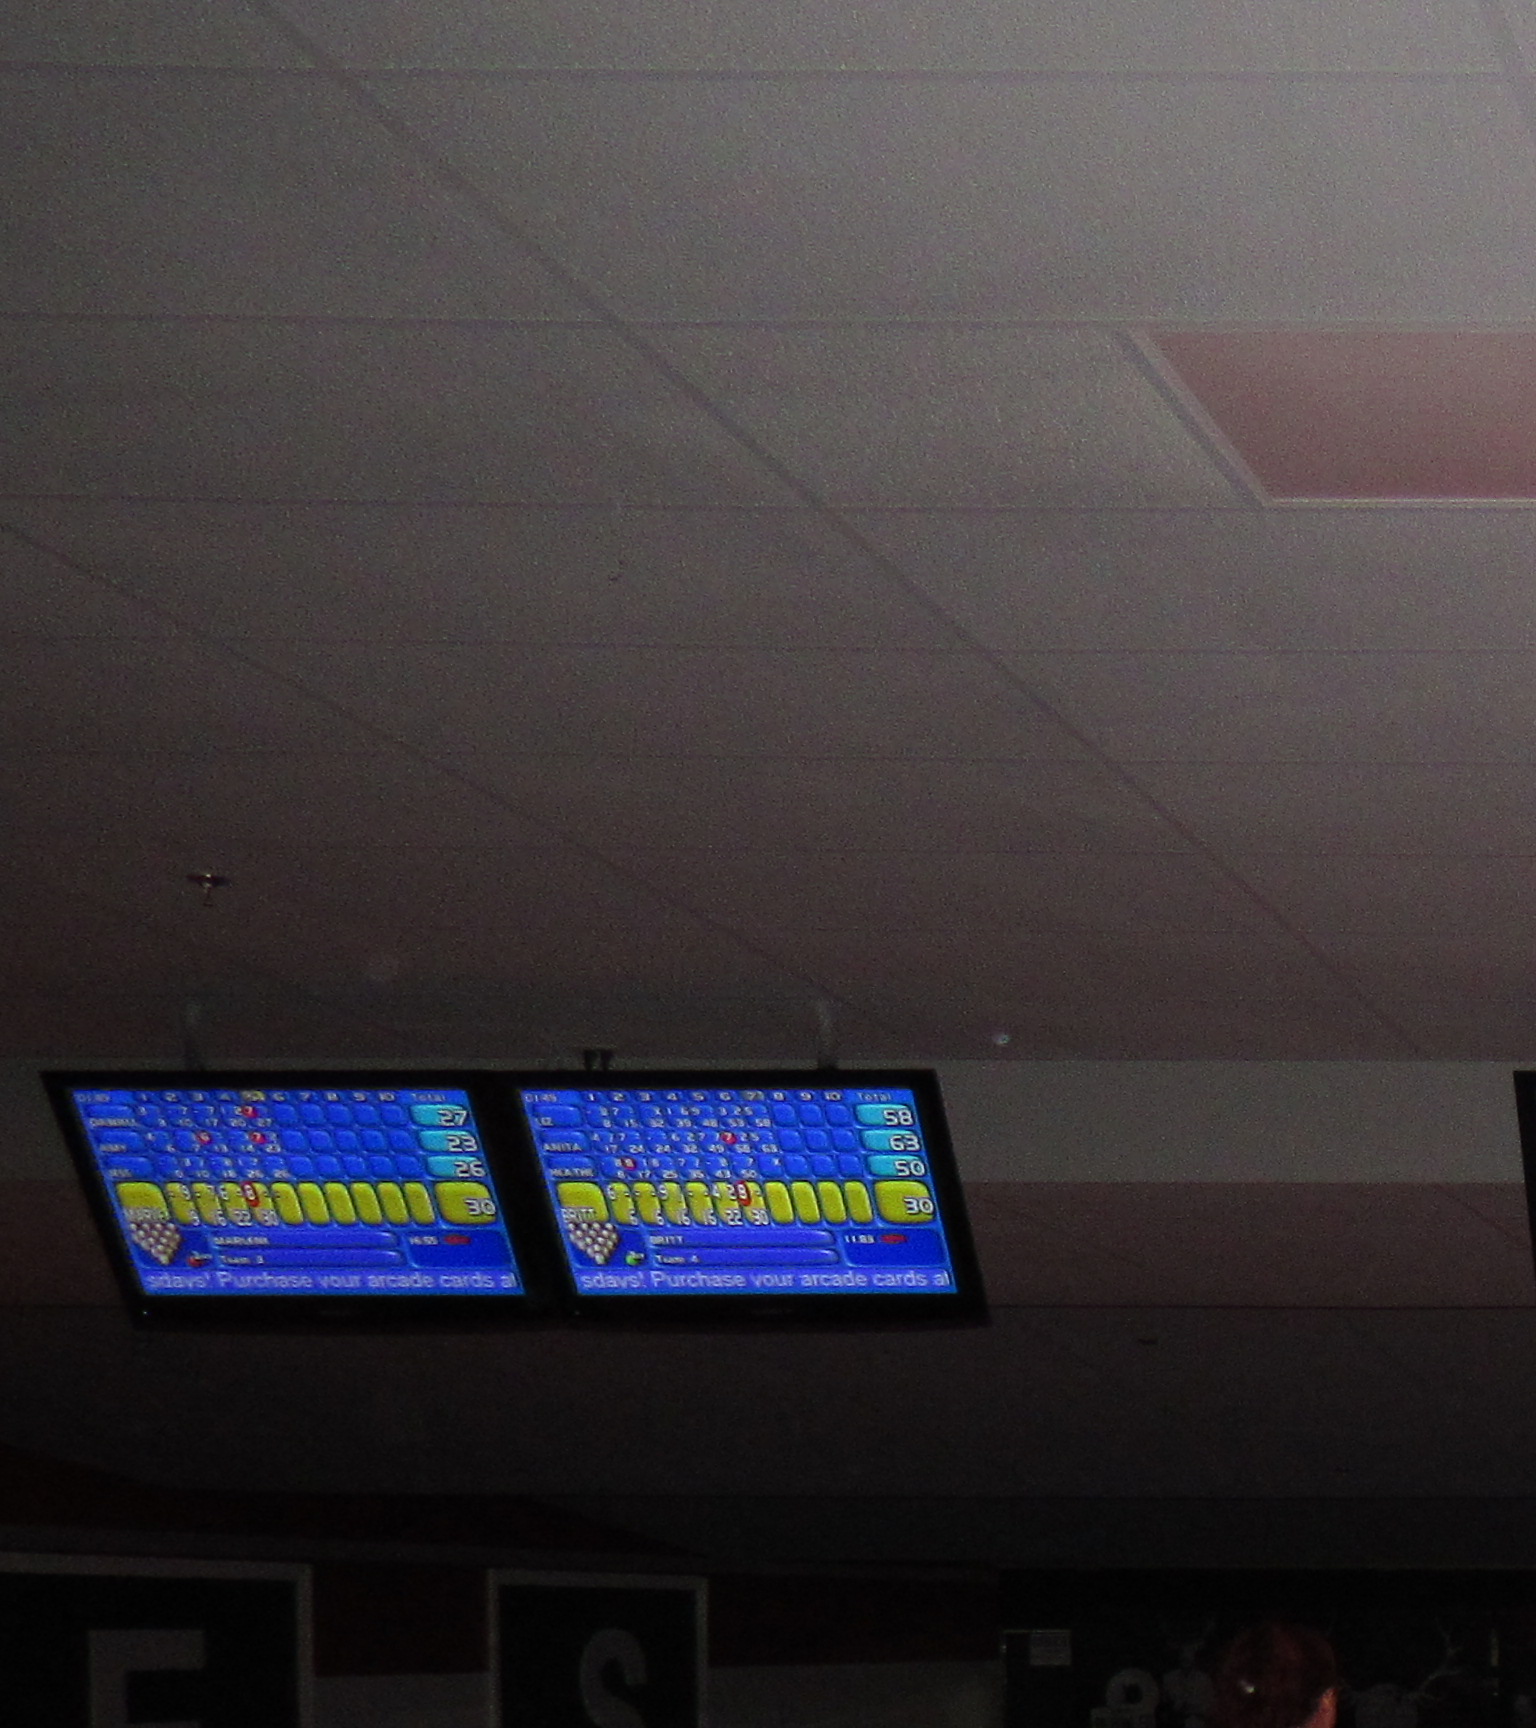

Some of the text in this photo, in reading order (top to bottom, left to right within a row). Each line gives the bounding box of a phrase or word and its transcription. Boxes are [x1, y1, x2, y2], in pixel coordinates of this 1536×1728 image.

[857, 1091, 892, 1101] Total
[438, 1110, 467, 1126] 27
[883, 1109, 914, 1126] 58
[446, 1135, 477, 1152] 23
[889, 1136, 920, 1152] 63
[455, 1161, 486, 1178] 26
[894, 1160, 925, 1177] 50
[465, 1198, 496, 1215] 30
[904, 1197, 934, 1214] 30
[216, 1271, 313, 1288] Purchase
[320, 1274, 361, 1289] your
[367, 1271, 434, 1288] arcade
[440, 1271, 496, 1288] cards
[651, 1270, 746, 1287] Purchase
[755, 1274, 794, 1288] your
[801, 1270, 868, 1286] arcade
[873, 1270, 928, 1286] cards
